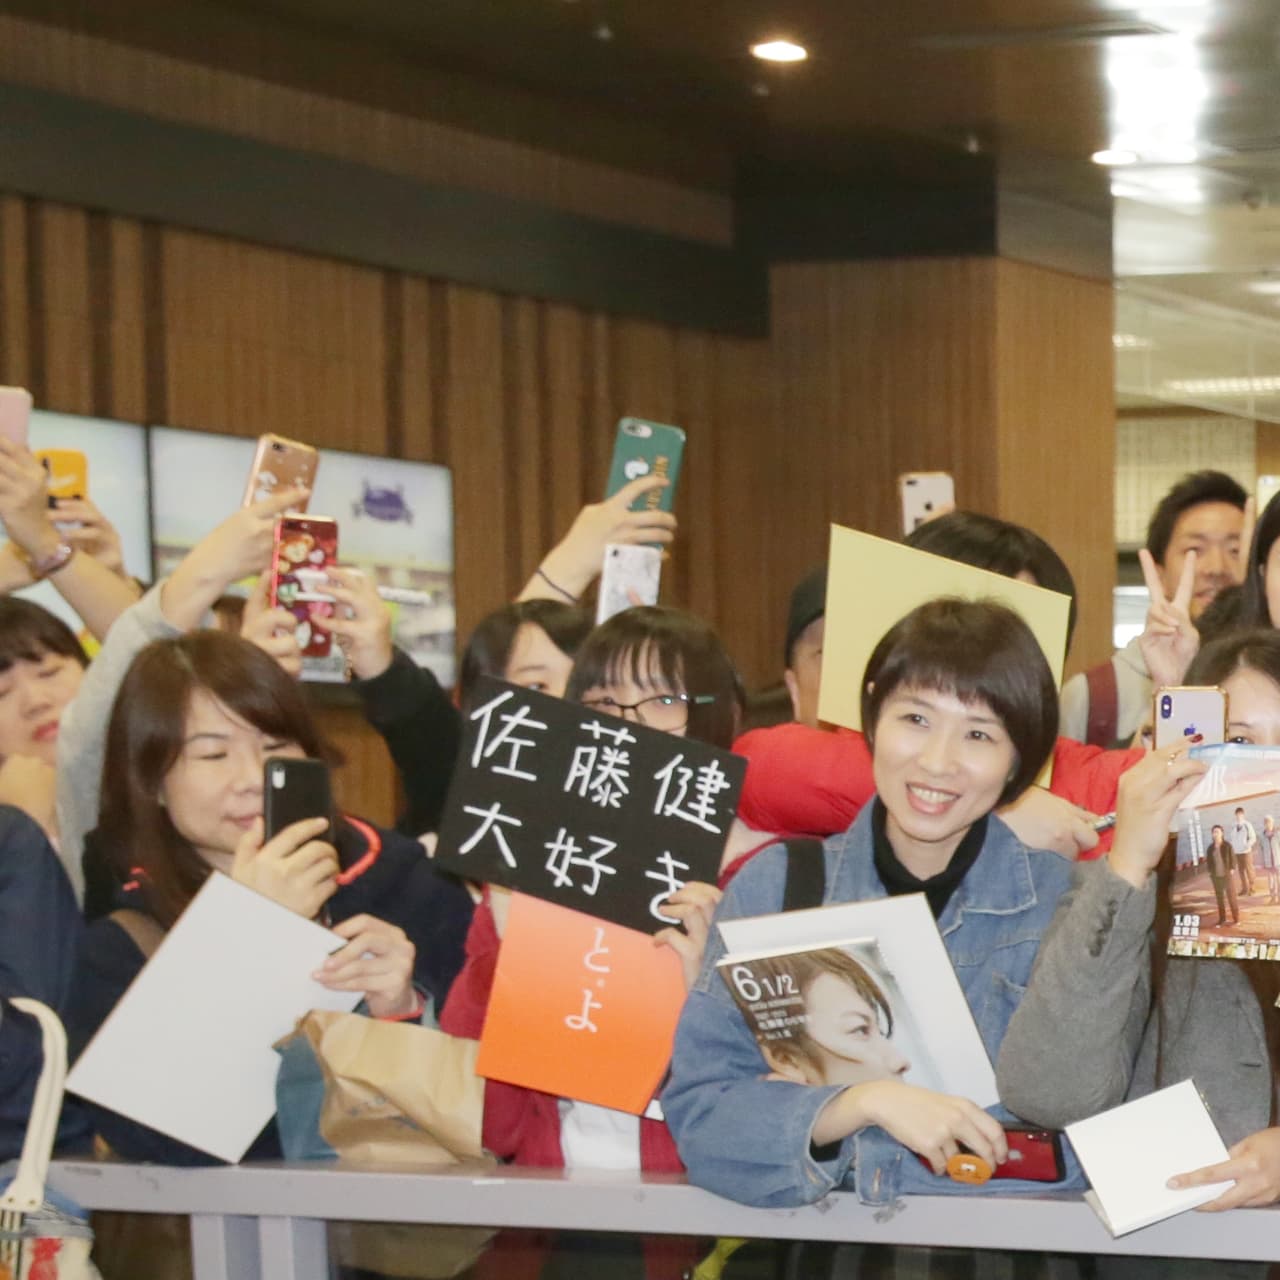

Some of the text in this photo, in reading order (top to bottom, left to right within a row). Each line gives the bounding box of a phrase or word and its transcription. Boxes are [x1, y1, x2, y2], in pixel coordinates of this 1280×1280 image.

[469, 690, 731, 834] 佐藤健
[458, 802, 691, 925] 大好き
[1174, 914, 1201, 927] 1.03
[731, 965, 762, 1002] 6
